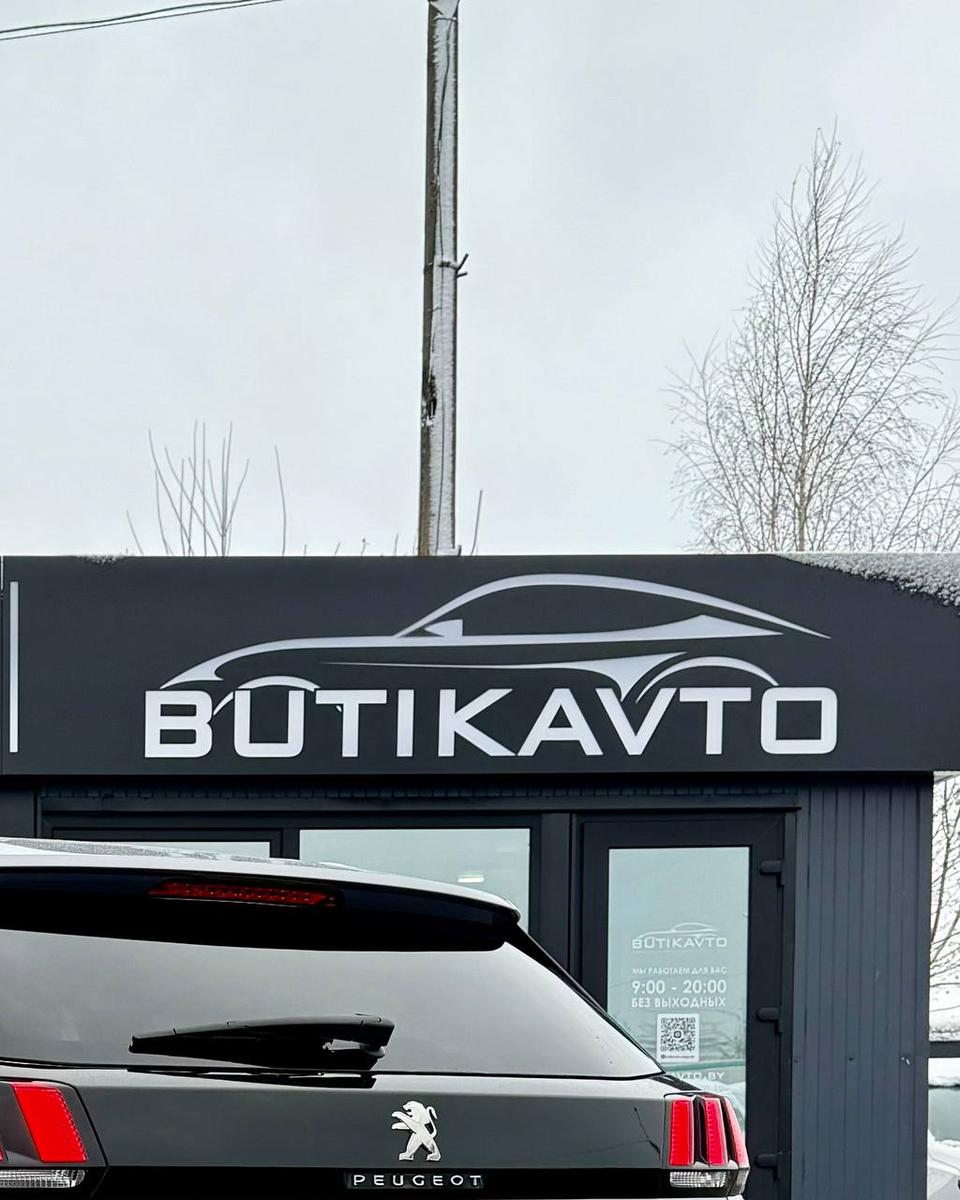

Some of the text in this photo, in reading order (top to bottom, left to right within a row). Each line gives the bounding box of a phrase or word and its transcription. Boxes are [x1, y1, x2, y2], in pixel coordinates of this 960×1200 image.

[143, 686, 838, 759] BUTIKAVTO
[632, 936, 728, 949] BUTIKAVTO
[632, 966, 728, 975] МЫ РАБОТАЕМ ДЛЯ ВАС
[632, 980, 665, 994] 9:00
[683, 979, 727, 994] 20:00
[631, 997, 726, 1009] БЕЗ ВЫХОДНЫХ
[353, 1175, 482, 1187] PEUGEOT
